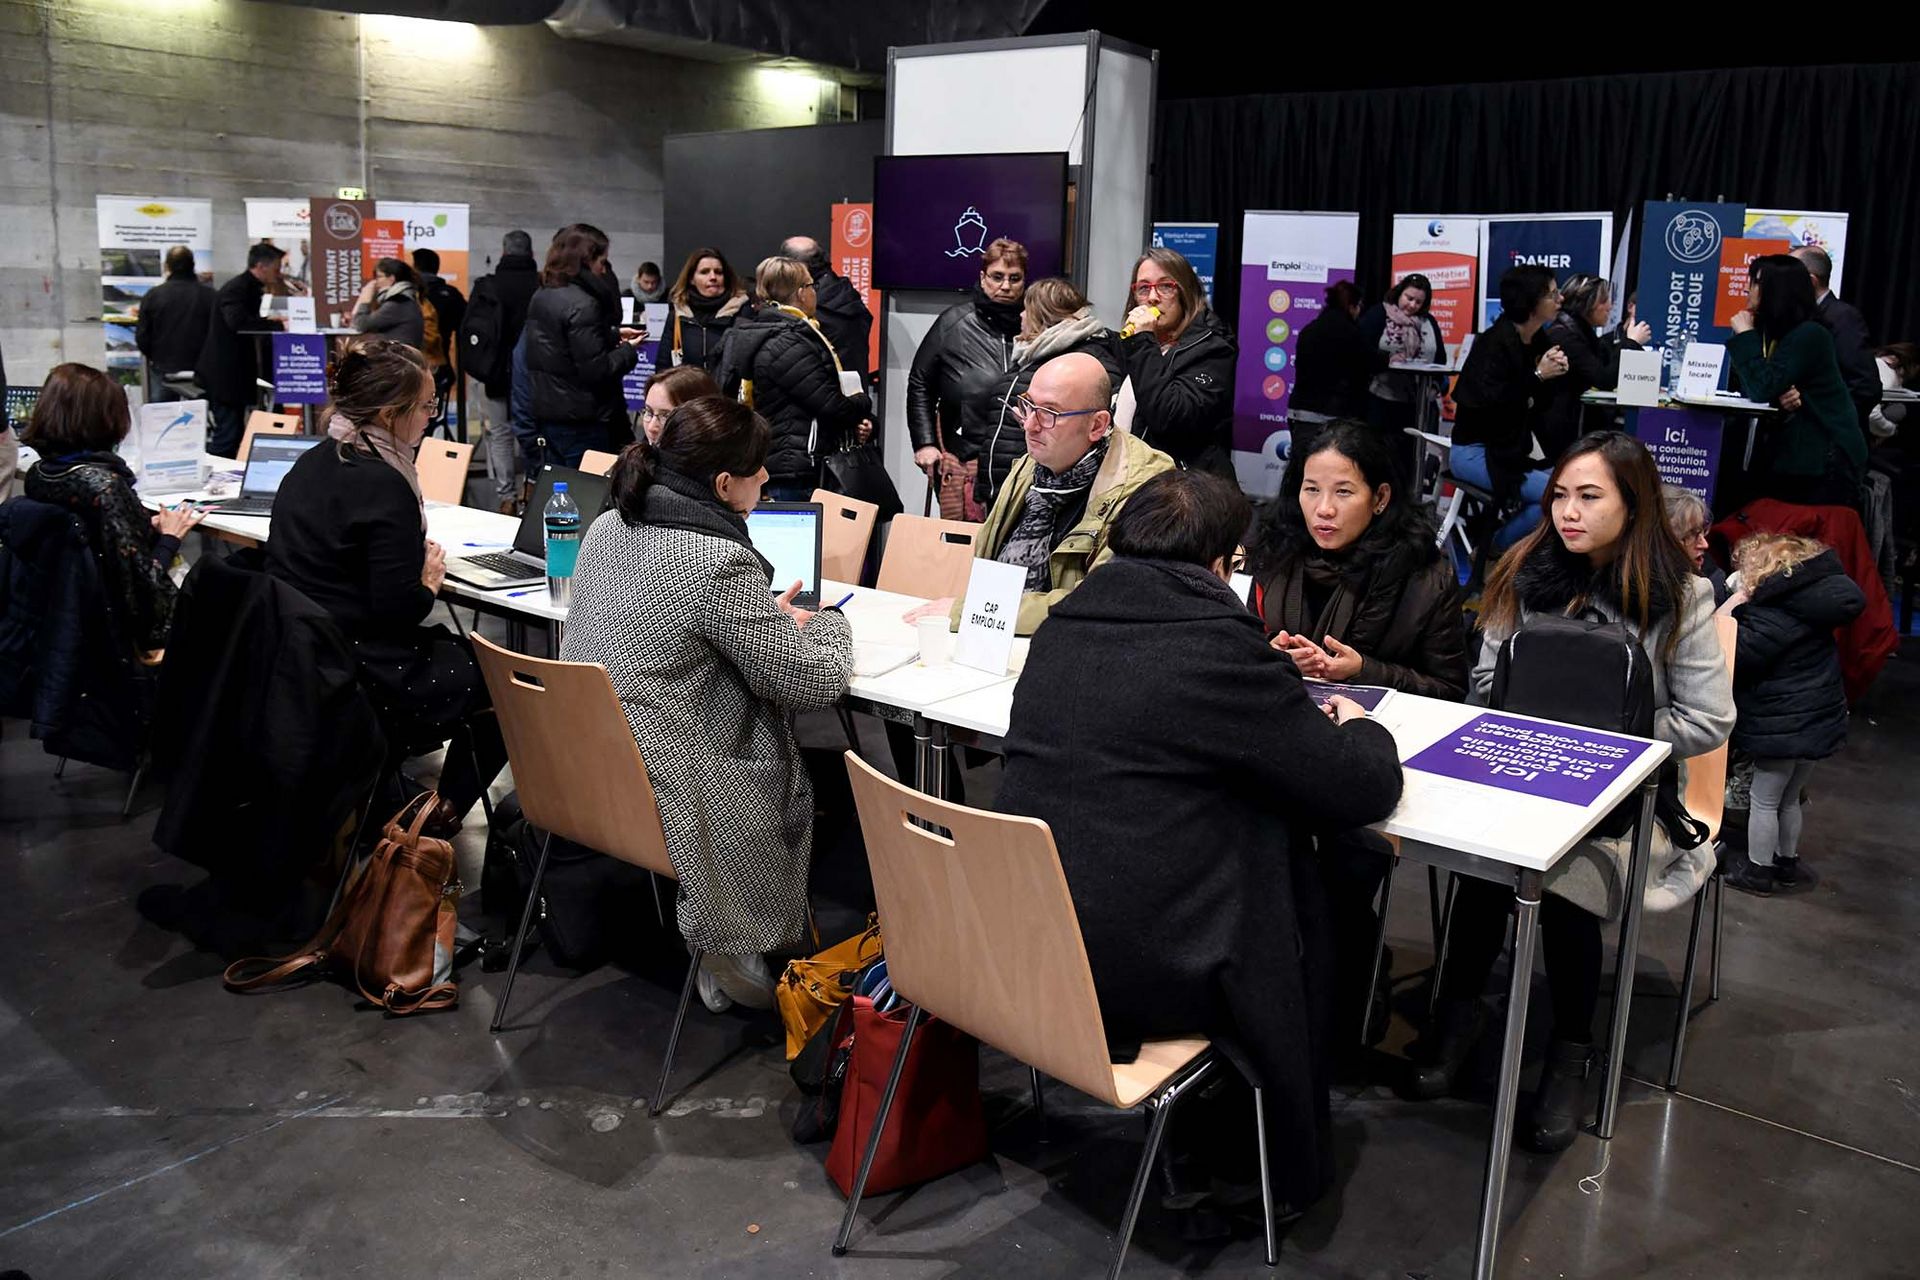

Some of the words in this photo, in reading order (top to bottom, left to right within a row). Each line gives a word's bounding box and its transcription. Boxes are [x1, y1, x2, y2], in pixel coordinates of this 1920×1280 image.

[403, 221, 436, 241] fpa
[1514, 255, 1571, 268] DAHER
[1744, 253, 1761, 265] Ic
[339, 249, 350, 303] TRAVAUX
[351, 249, 362, 296] PUBLICS
[1688, 360, 1718, 369] Mission
[1637, 374, 1656, 382] EMPLOI
[1688, 371, 1712, 379] locale
[1665, 427, 1689, 445] Ici,
[1659, 445, 1707, 457] conseillers
[1659, 454, 1706, 467] évolution
[1656, 463, 1710, 477] essionnelle
[1661, 475, 1683, 484] vous
[984, 601, 999, 614] CAP
[971, 613, 996, 629] EMPLOI
[996, 619, 1006, 631] 44
[1479, 720, 1533, 736] projet.
[1474, 727, 1624, 760] accompagnent
[1536, 731, 1579, 746] votre
[1459, 735, 1615, 771] professionnelle
[1518, 741, 1563, 754] vous
[1584, 741, 1630, 754] dans
[1454, 748, 1557, 772] conseillers
[1463, 742, 1560, 767] évolution
[1488, 762, 1540, 782] Ici,
[1562, 769, 1591, 781] les
[1570, 763, 1596, 774] en
